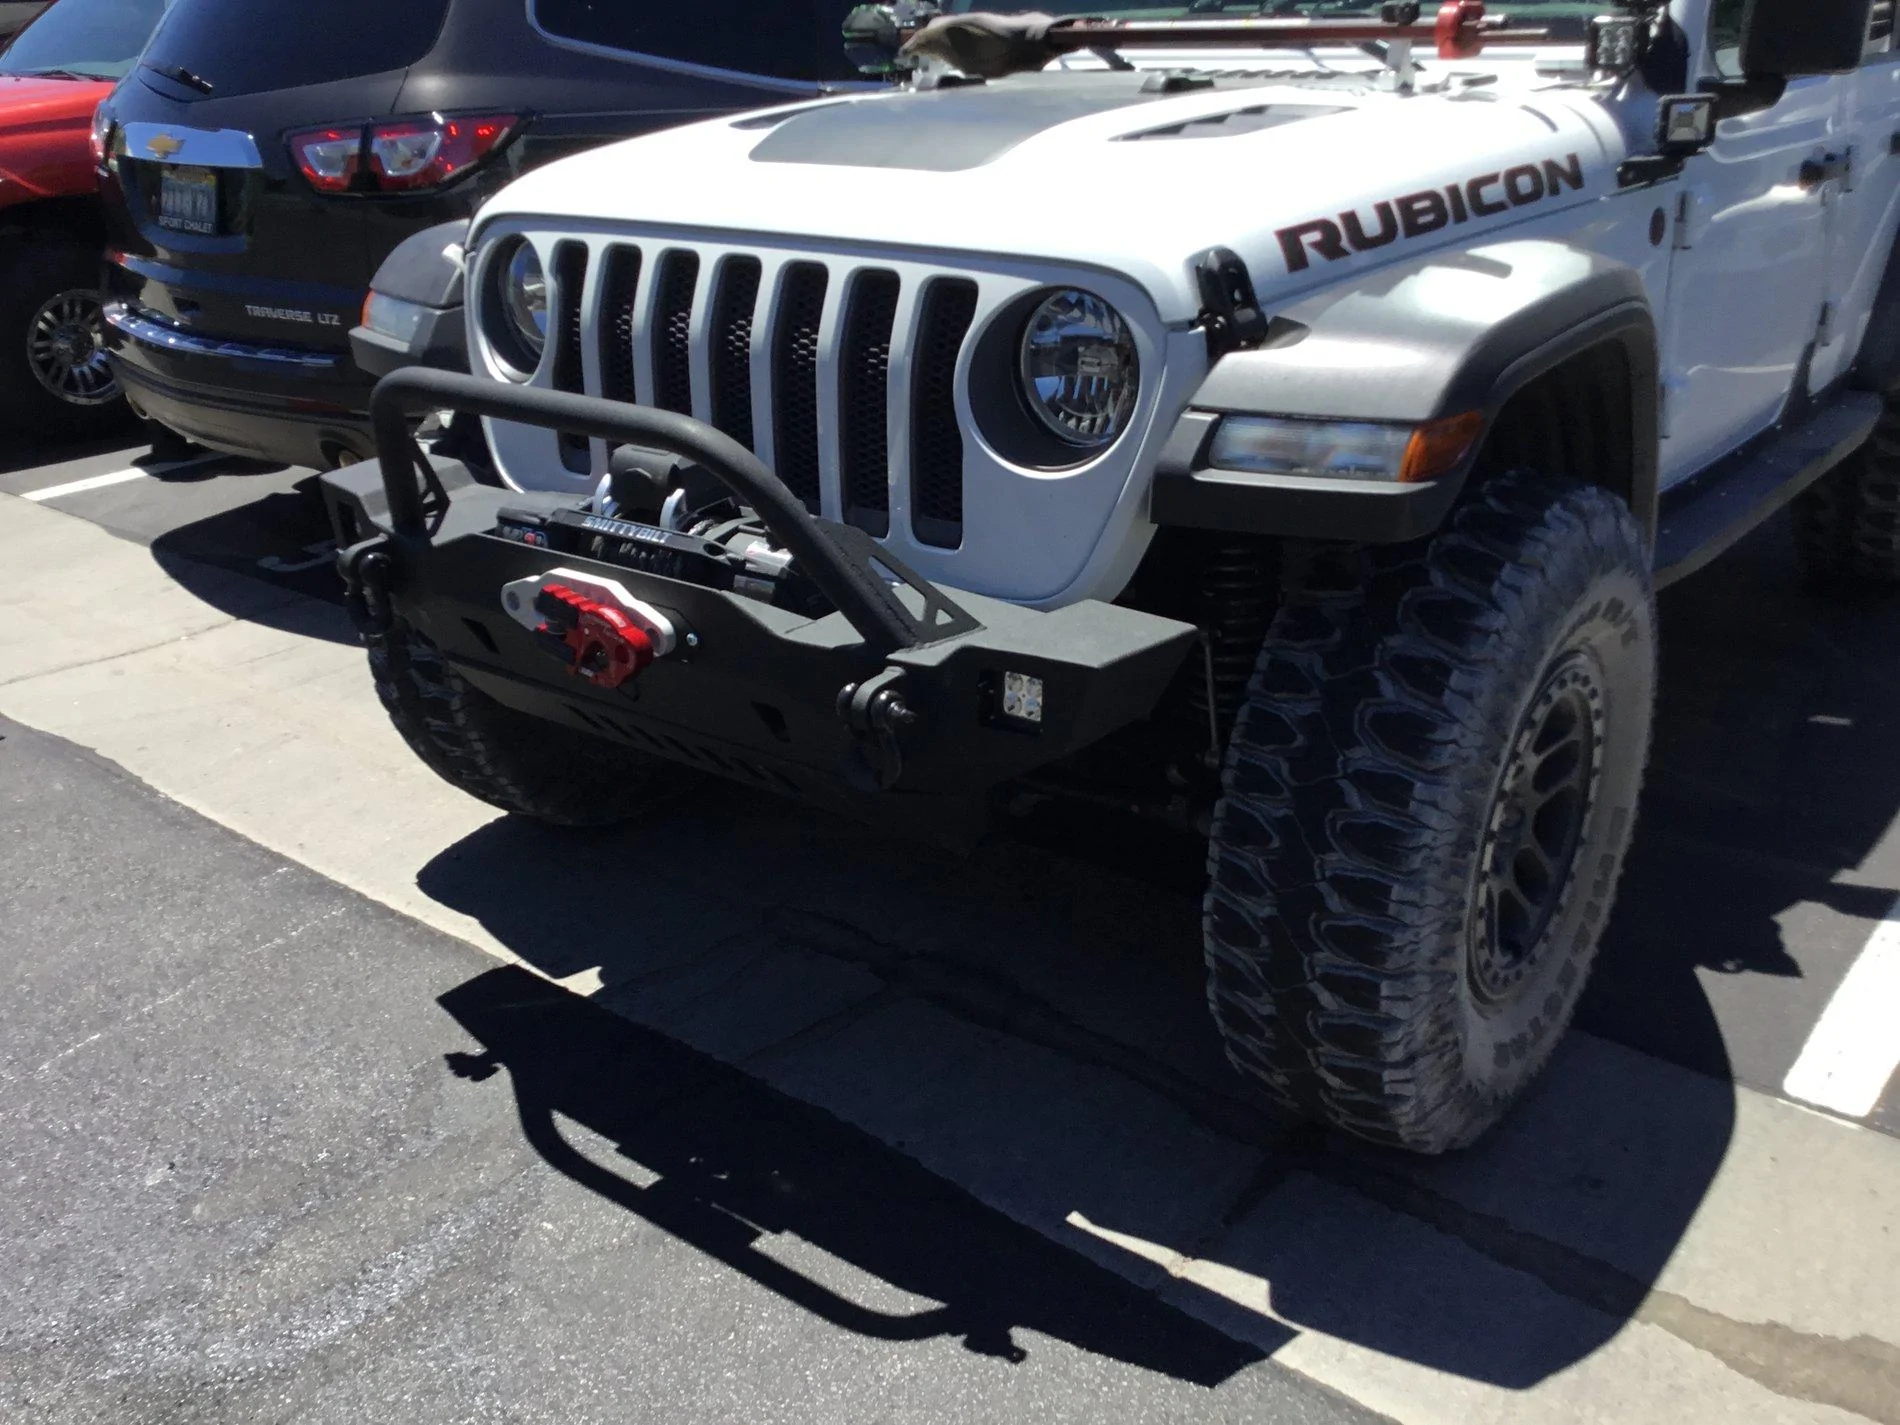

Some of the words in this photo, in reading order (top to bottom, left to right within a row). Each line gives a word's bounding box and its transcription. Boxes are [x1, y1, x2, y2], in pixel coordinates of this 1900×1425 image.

[158, 214, 182, 229] SPORT
[1274, 152, 1585, 273] RUBICON
[244, 304, 313, 323] TRAVERSE
[316, 312, 341, 326] LTZ
[581, 515, 673, 544] SMITTYBILT
